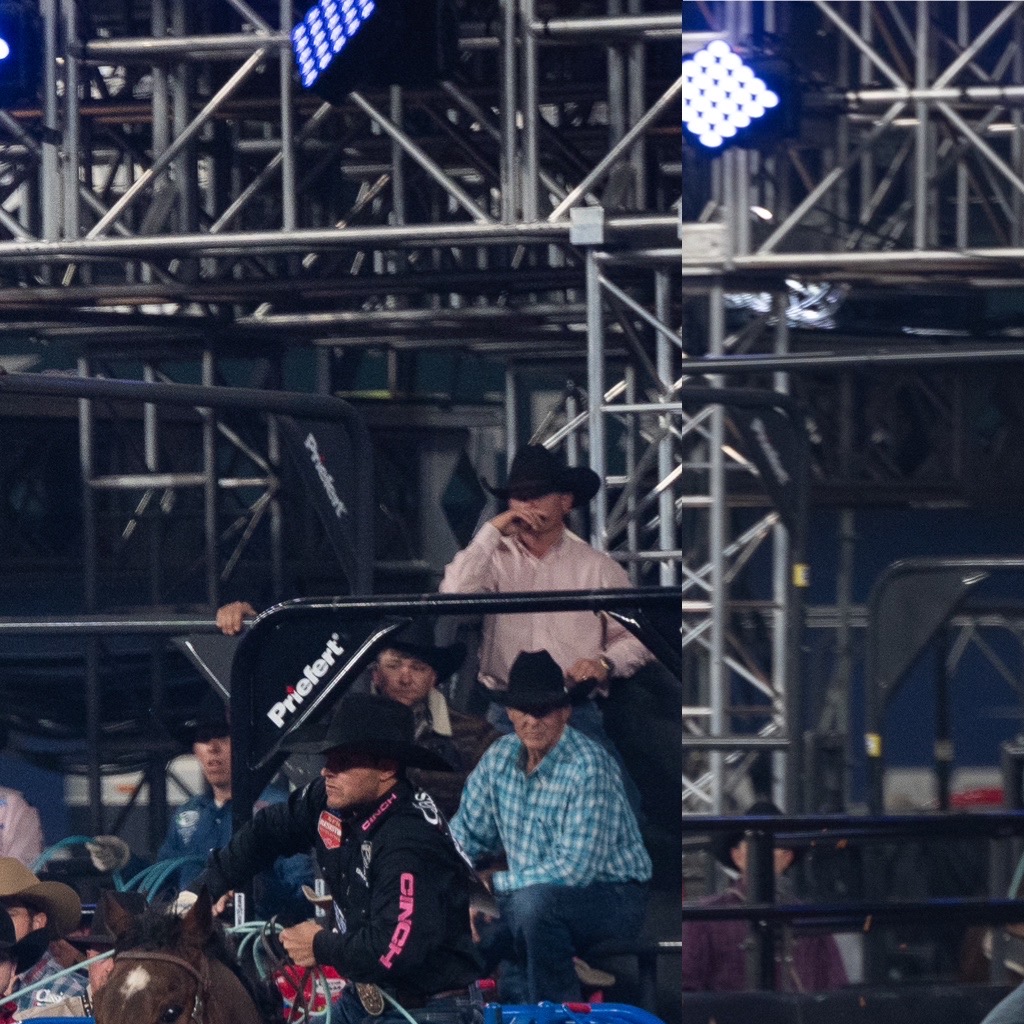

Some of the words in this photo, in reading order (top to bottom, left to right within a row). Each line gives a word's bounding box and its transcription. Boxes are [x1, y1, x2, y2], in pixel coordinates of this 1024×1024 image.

[267, 632, 344, 728] Priefert
[361, 793, 397, 830] CINCH
[379, 872, 414, 968] CINCH
